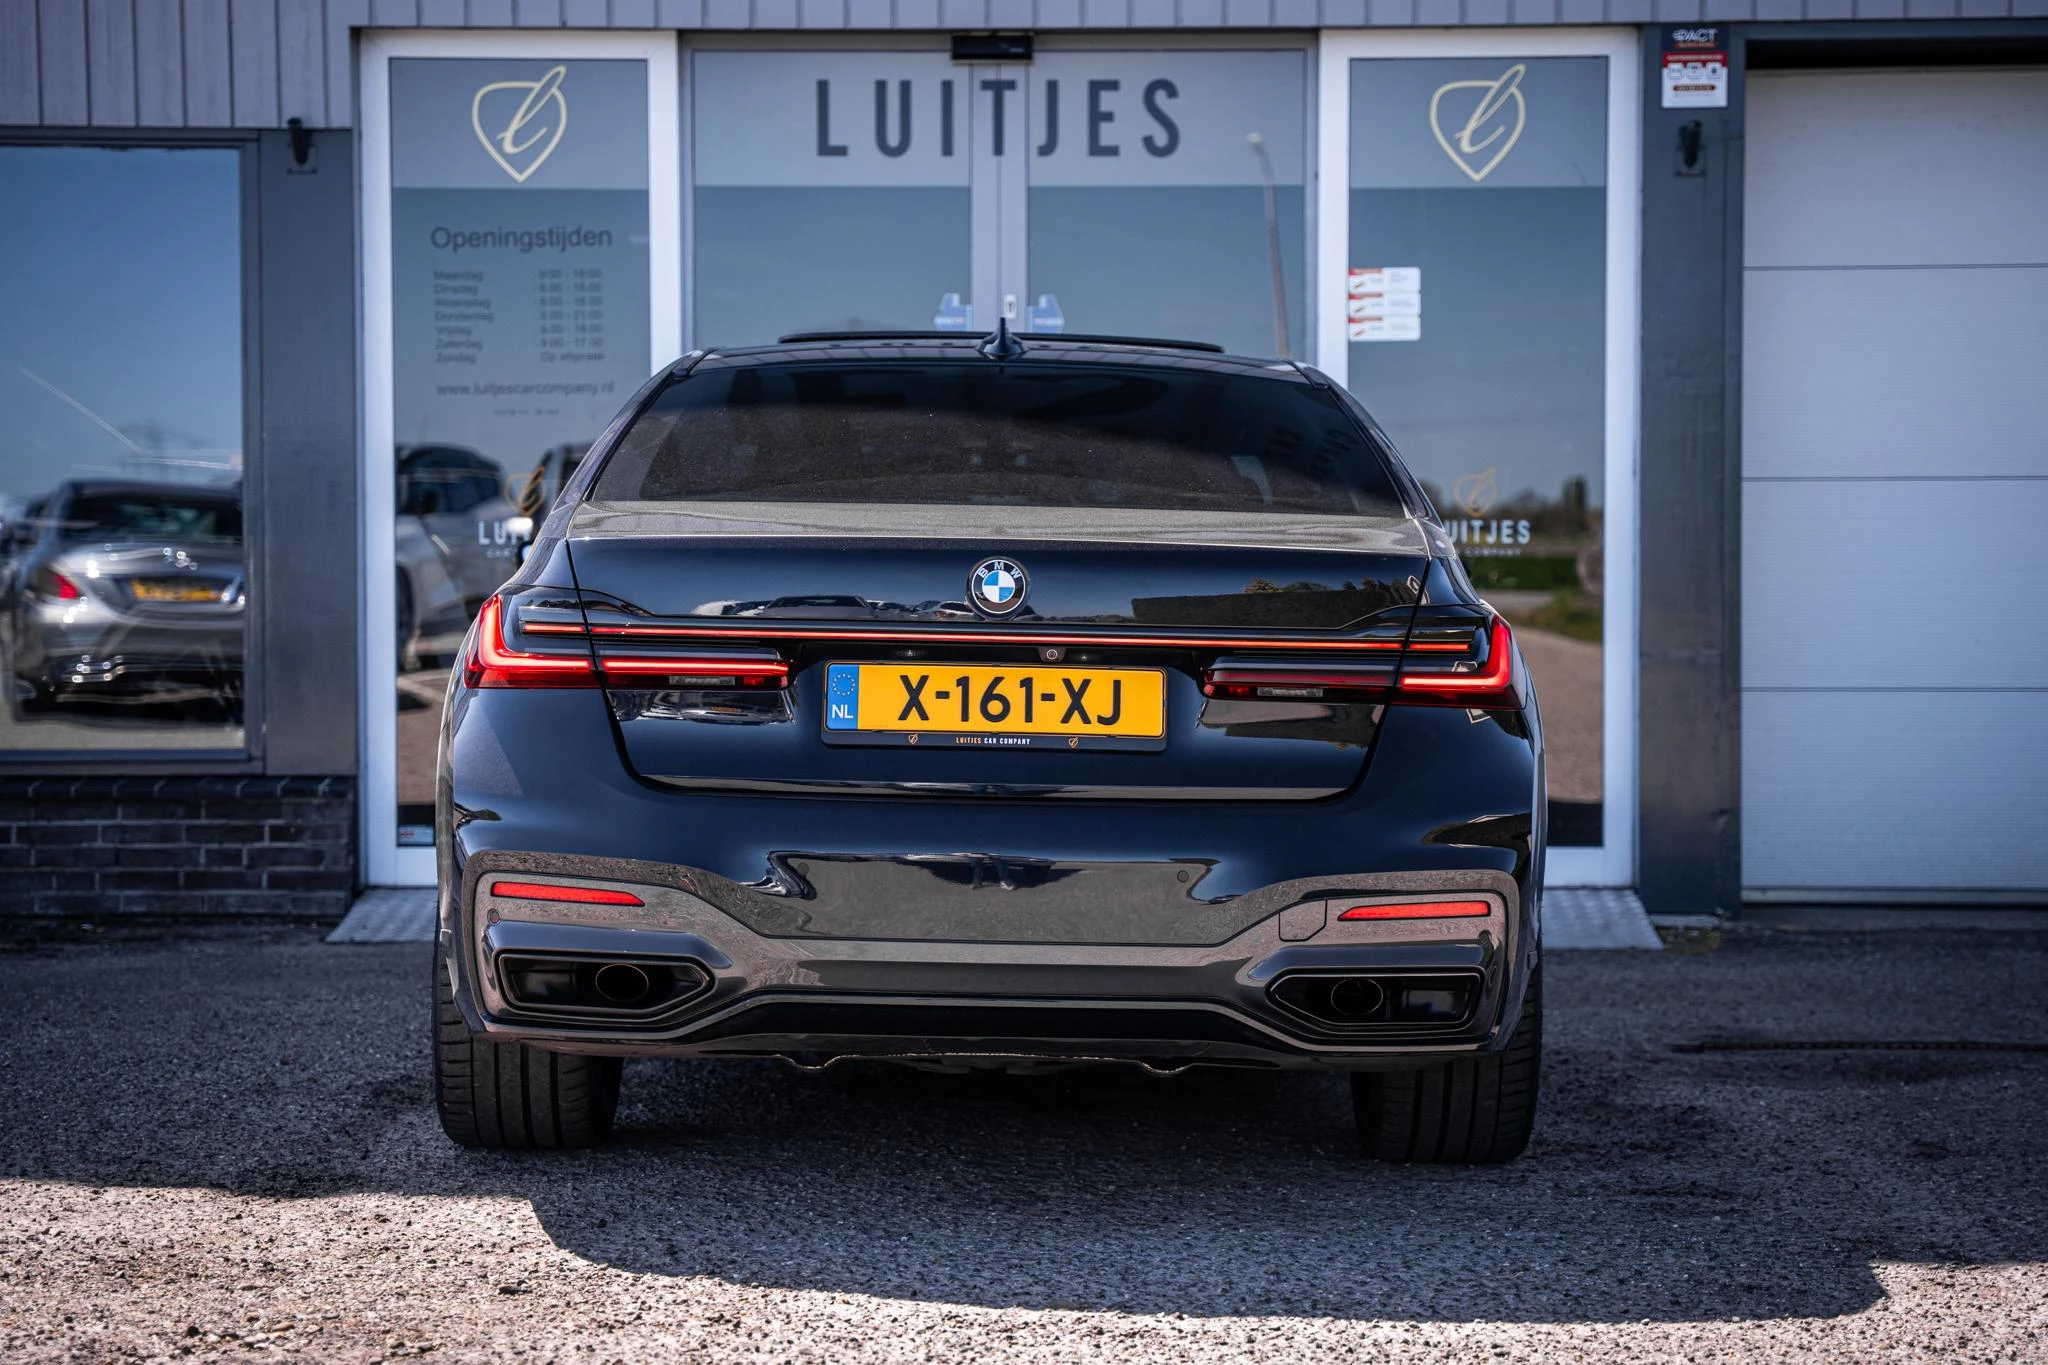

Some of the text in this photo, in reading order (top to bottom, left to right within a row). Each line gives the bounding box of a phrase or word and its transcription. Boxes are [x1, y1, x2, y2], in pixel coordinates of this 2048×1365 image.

[816, 78, 1180, 157] LUITJES
[430, 226, 613, 253] Openingstijden
[1445, 519, 1531, 545] UITJES
[977, 561, 1022, 579] BMW
[832, 704, 854, 720] NL
[898, 674, 1122, 726] X-161-XJ
